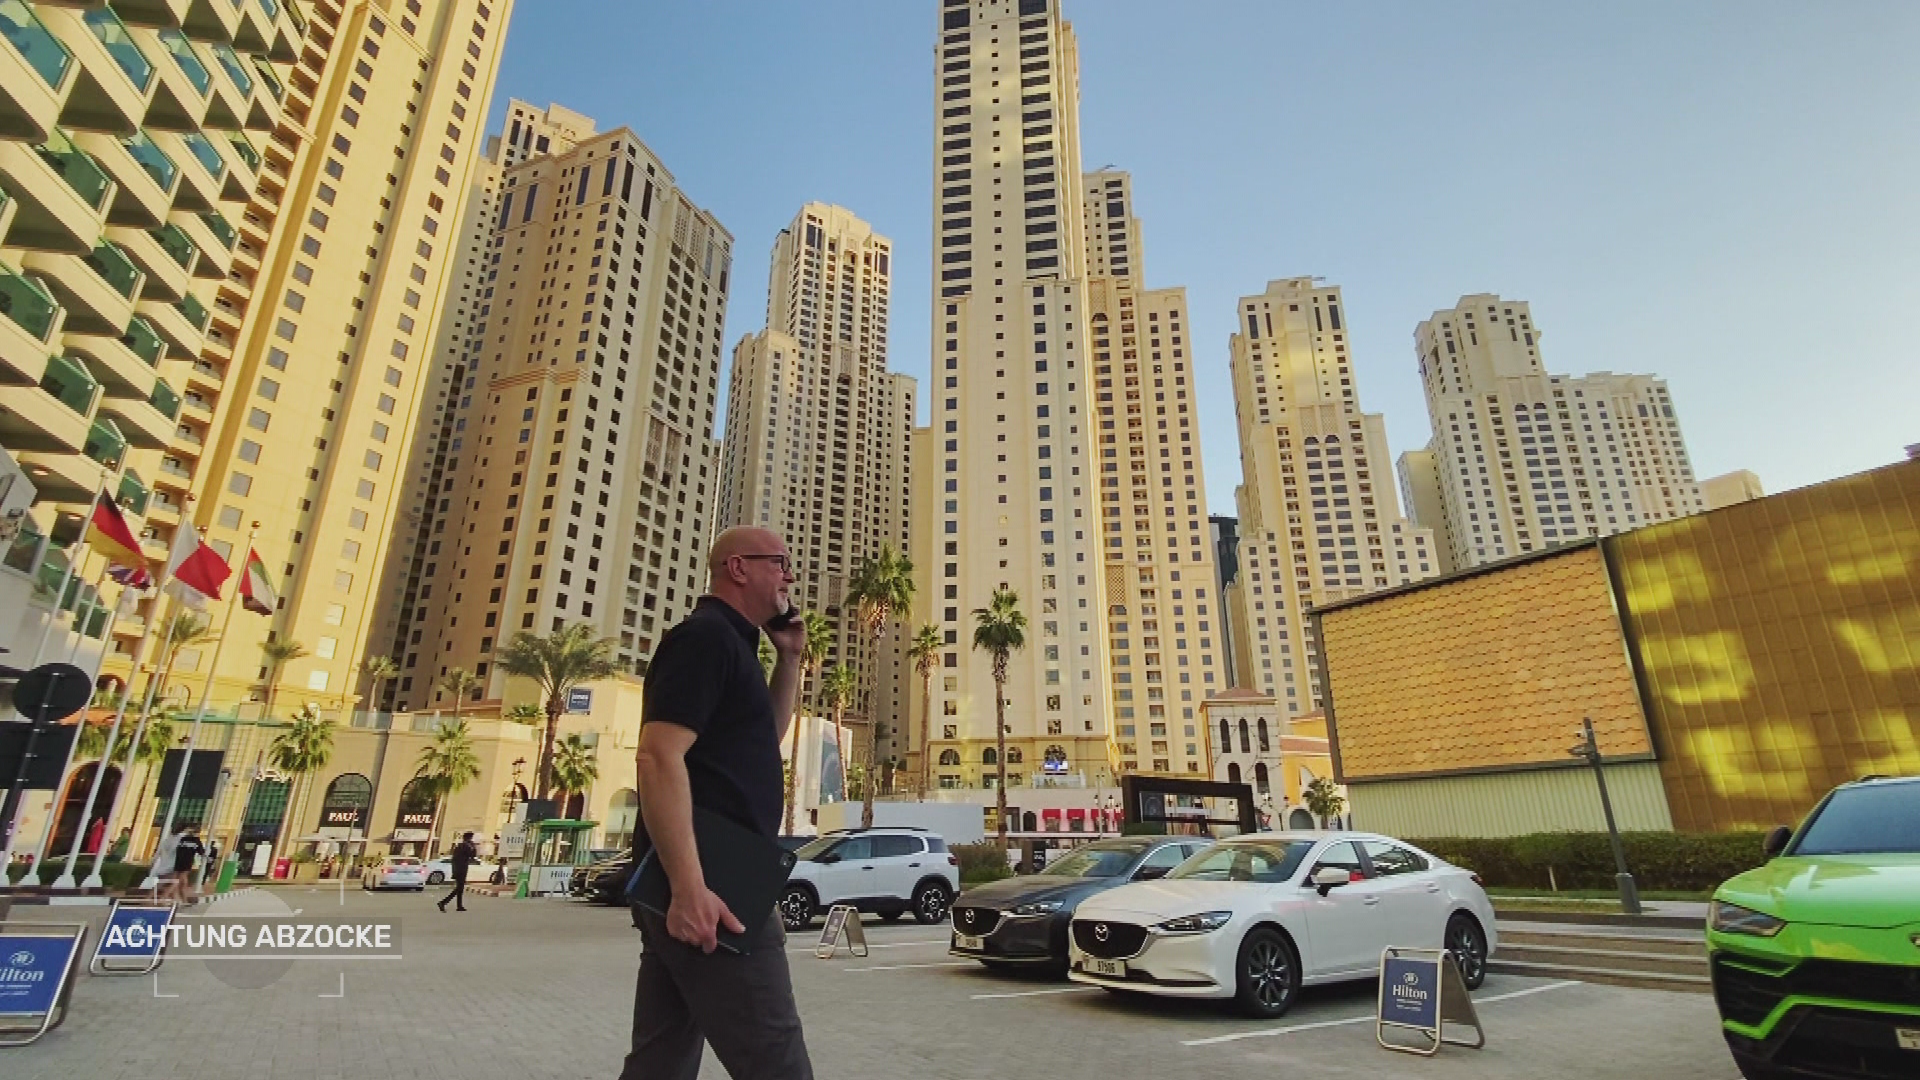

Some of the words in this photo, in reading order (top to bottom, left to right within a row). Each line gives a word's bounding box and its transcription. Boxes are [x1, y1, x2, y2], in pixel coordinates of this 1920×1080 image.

[328, 812, 359, 821] PAUL
[403, 814, 432, 823] PAUL
[0, 968, 44, 982] ilton
[1392, 984, 1428, 1000] Hilton
